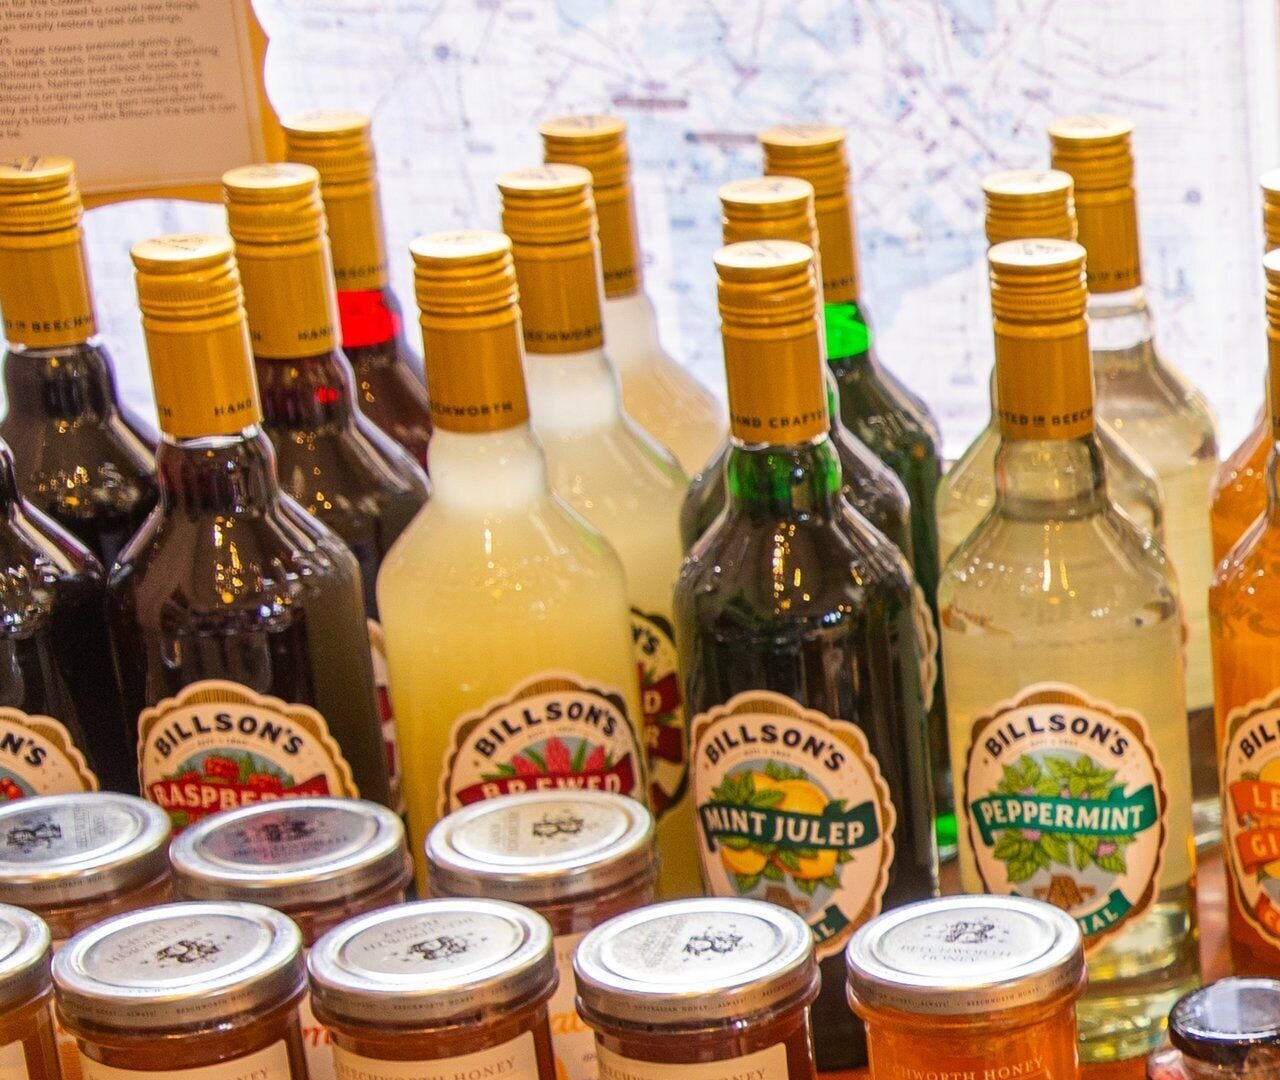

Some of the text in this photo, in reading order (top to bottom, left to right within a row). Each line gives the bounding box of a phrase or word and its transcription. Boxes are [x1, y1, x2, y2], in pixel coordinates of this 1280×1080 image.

[154, 713, 304, 759] BILLSON'S
[474, 701, 618, 758] BILLSON'S
[704, 724, 845, 772] BILLSON'S
[984, 714, 1130, 759] BILLSON'S
[702, 806, 865, 847] MINT JULEP
[979, 799, 1145, 832] PEPPERMINT
